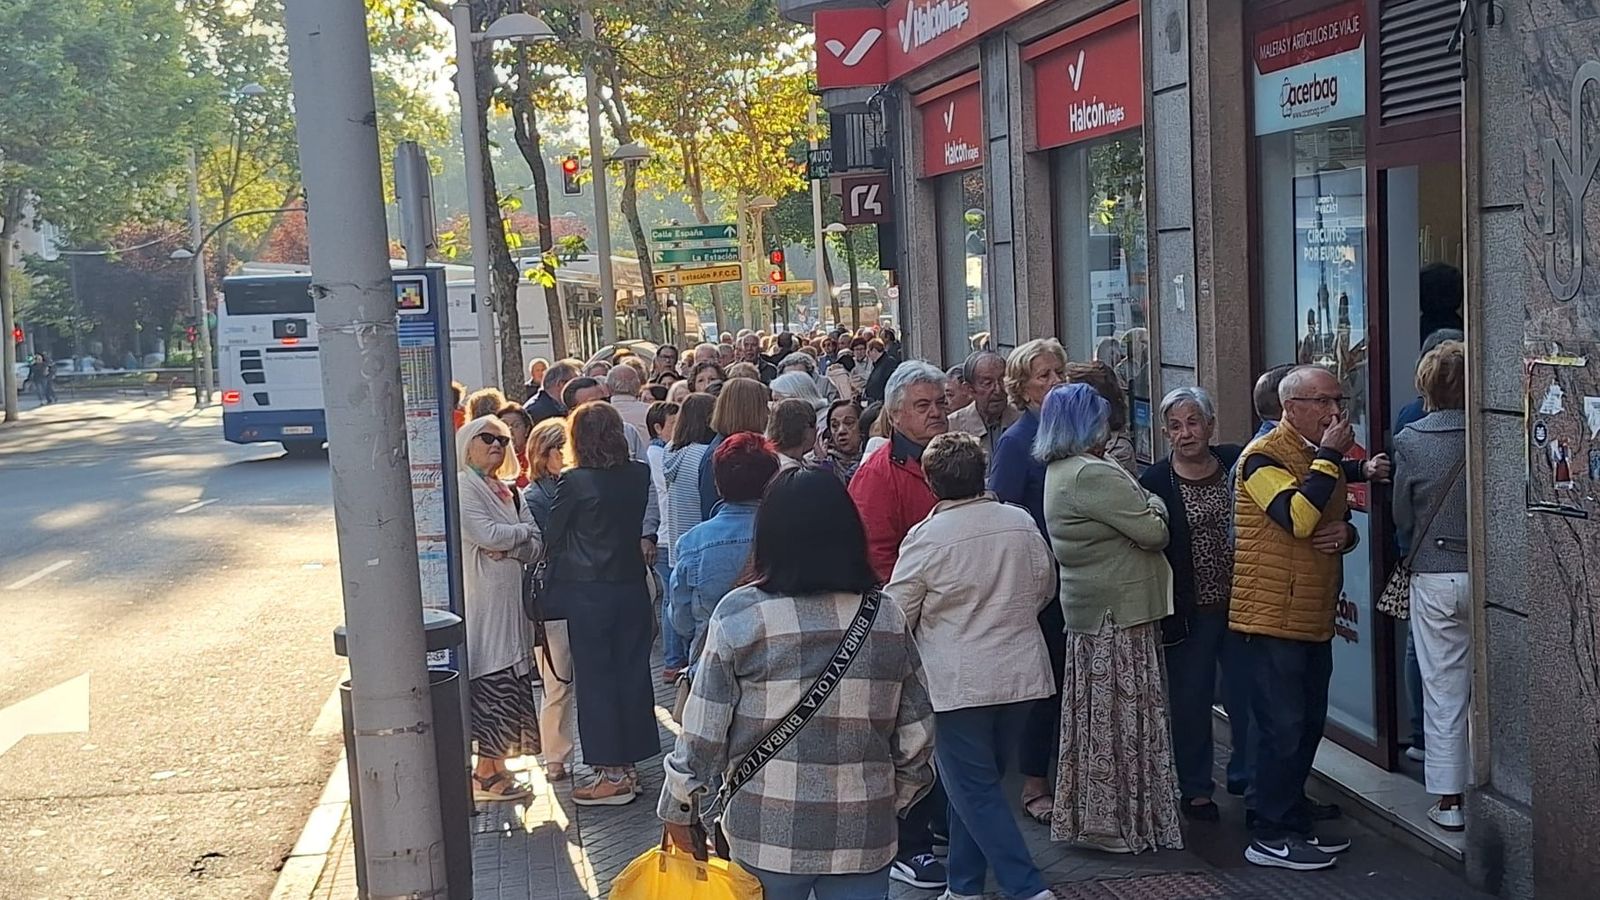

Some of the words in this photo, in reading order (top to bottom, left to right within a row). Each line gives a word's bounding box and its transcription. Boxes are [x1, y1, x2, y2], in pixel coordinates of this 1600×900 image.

[1260, 37, 1286, 60] MALETAS
[1292, 25, 1328, 51] ARTÍCULOS
[1328, 21, 1339, 40] DE
[1340, 15, 1360, 37] VIAJE
[1290, 73, 1337, 106] acerbag
[1070, 95, 1105, 134] Halcón
[1105, 102, 1125, 126] viajes
[944, 137, 967, 166] Halcón
[1307, 226, 1347, 244] CIRCUITOS
[704, 252, 738, 260] Estación
[1304, 247, 1320, 261] POR
[838, 615, 869, 660] BIMBA
[802, 671, 836, 708] LOLA
[761, 714, 803, 752] BIMBA
[732, 757, 758, 785] LOLA
